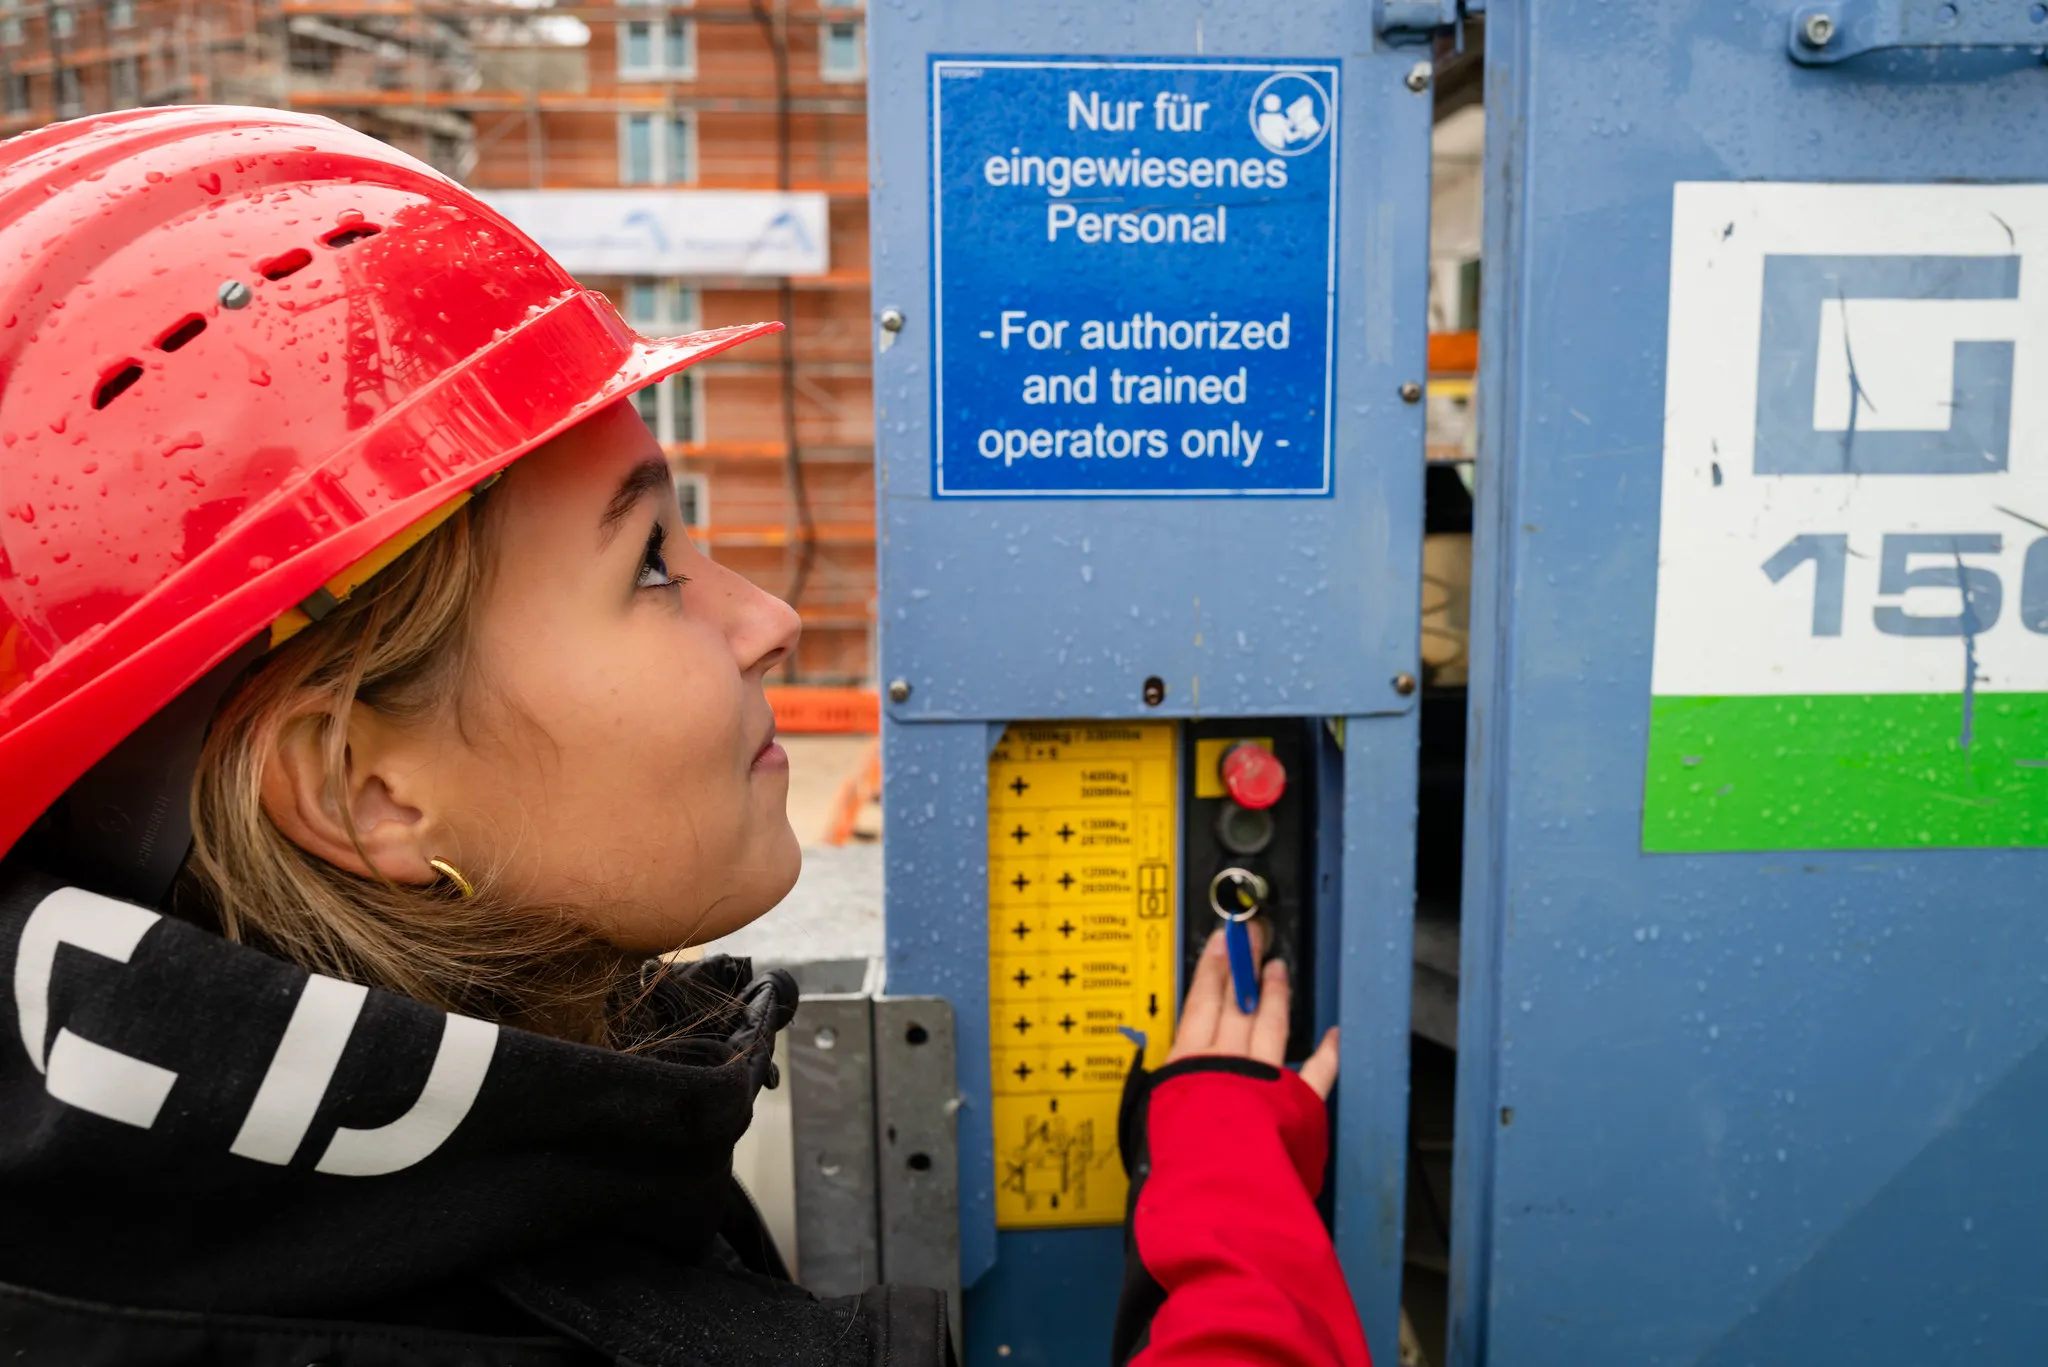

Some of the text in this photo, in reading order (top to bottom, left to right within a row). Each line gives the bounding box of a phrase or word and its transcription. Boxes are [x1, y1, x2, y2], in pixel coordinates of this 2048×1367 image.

[1068, 91, 1211, 131] Nur für
[984, 147, 1288, 196] eingewiesenes
[1047, 204, 1226, 244] Personal
[1080, 312, 1290, 350] authorized
[1023, 367, 1247, 405] and trained
[978, 423, 1168, 467] operators
[1181, 421, 1263, 467] only
[1760, 533, 2048, 637] 15
